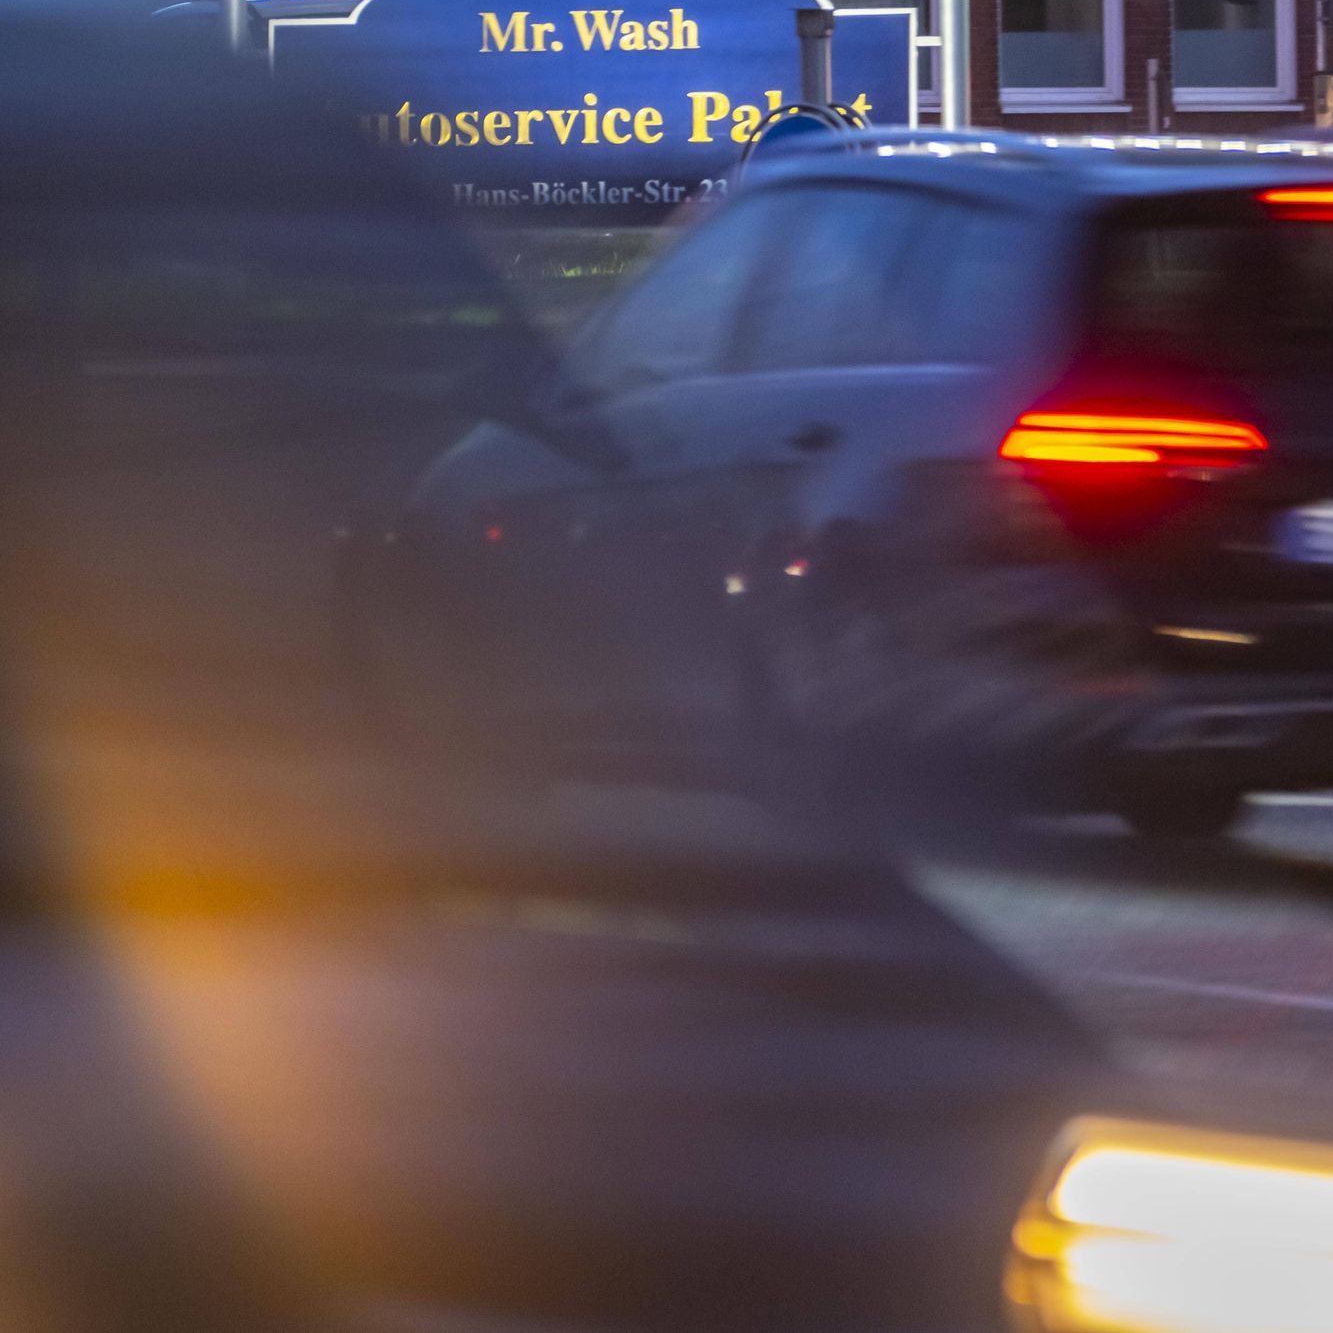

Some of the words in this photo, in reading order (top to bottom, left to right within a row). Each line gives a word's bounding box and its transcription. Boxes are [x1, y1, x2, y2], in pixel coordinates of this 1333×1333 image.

[478, 11, 564, 53] Mr.
[568, 8, 702, 51] Wash
[354, 92, 664, 146] utoservice
[453, 178, 692, 208] Hans-Böckler-Str.
